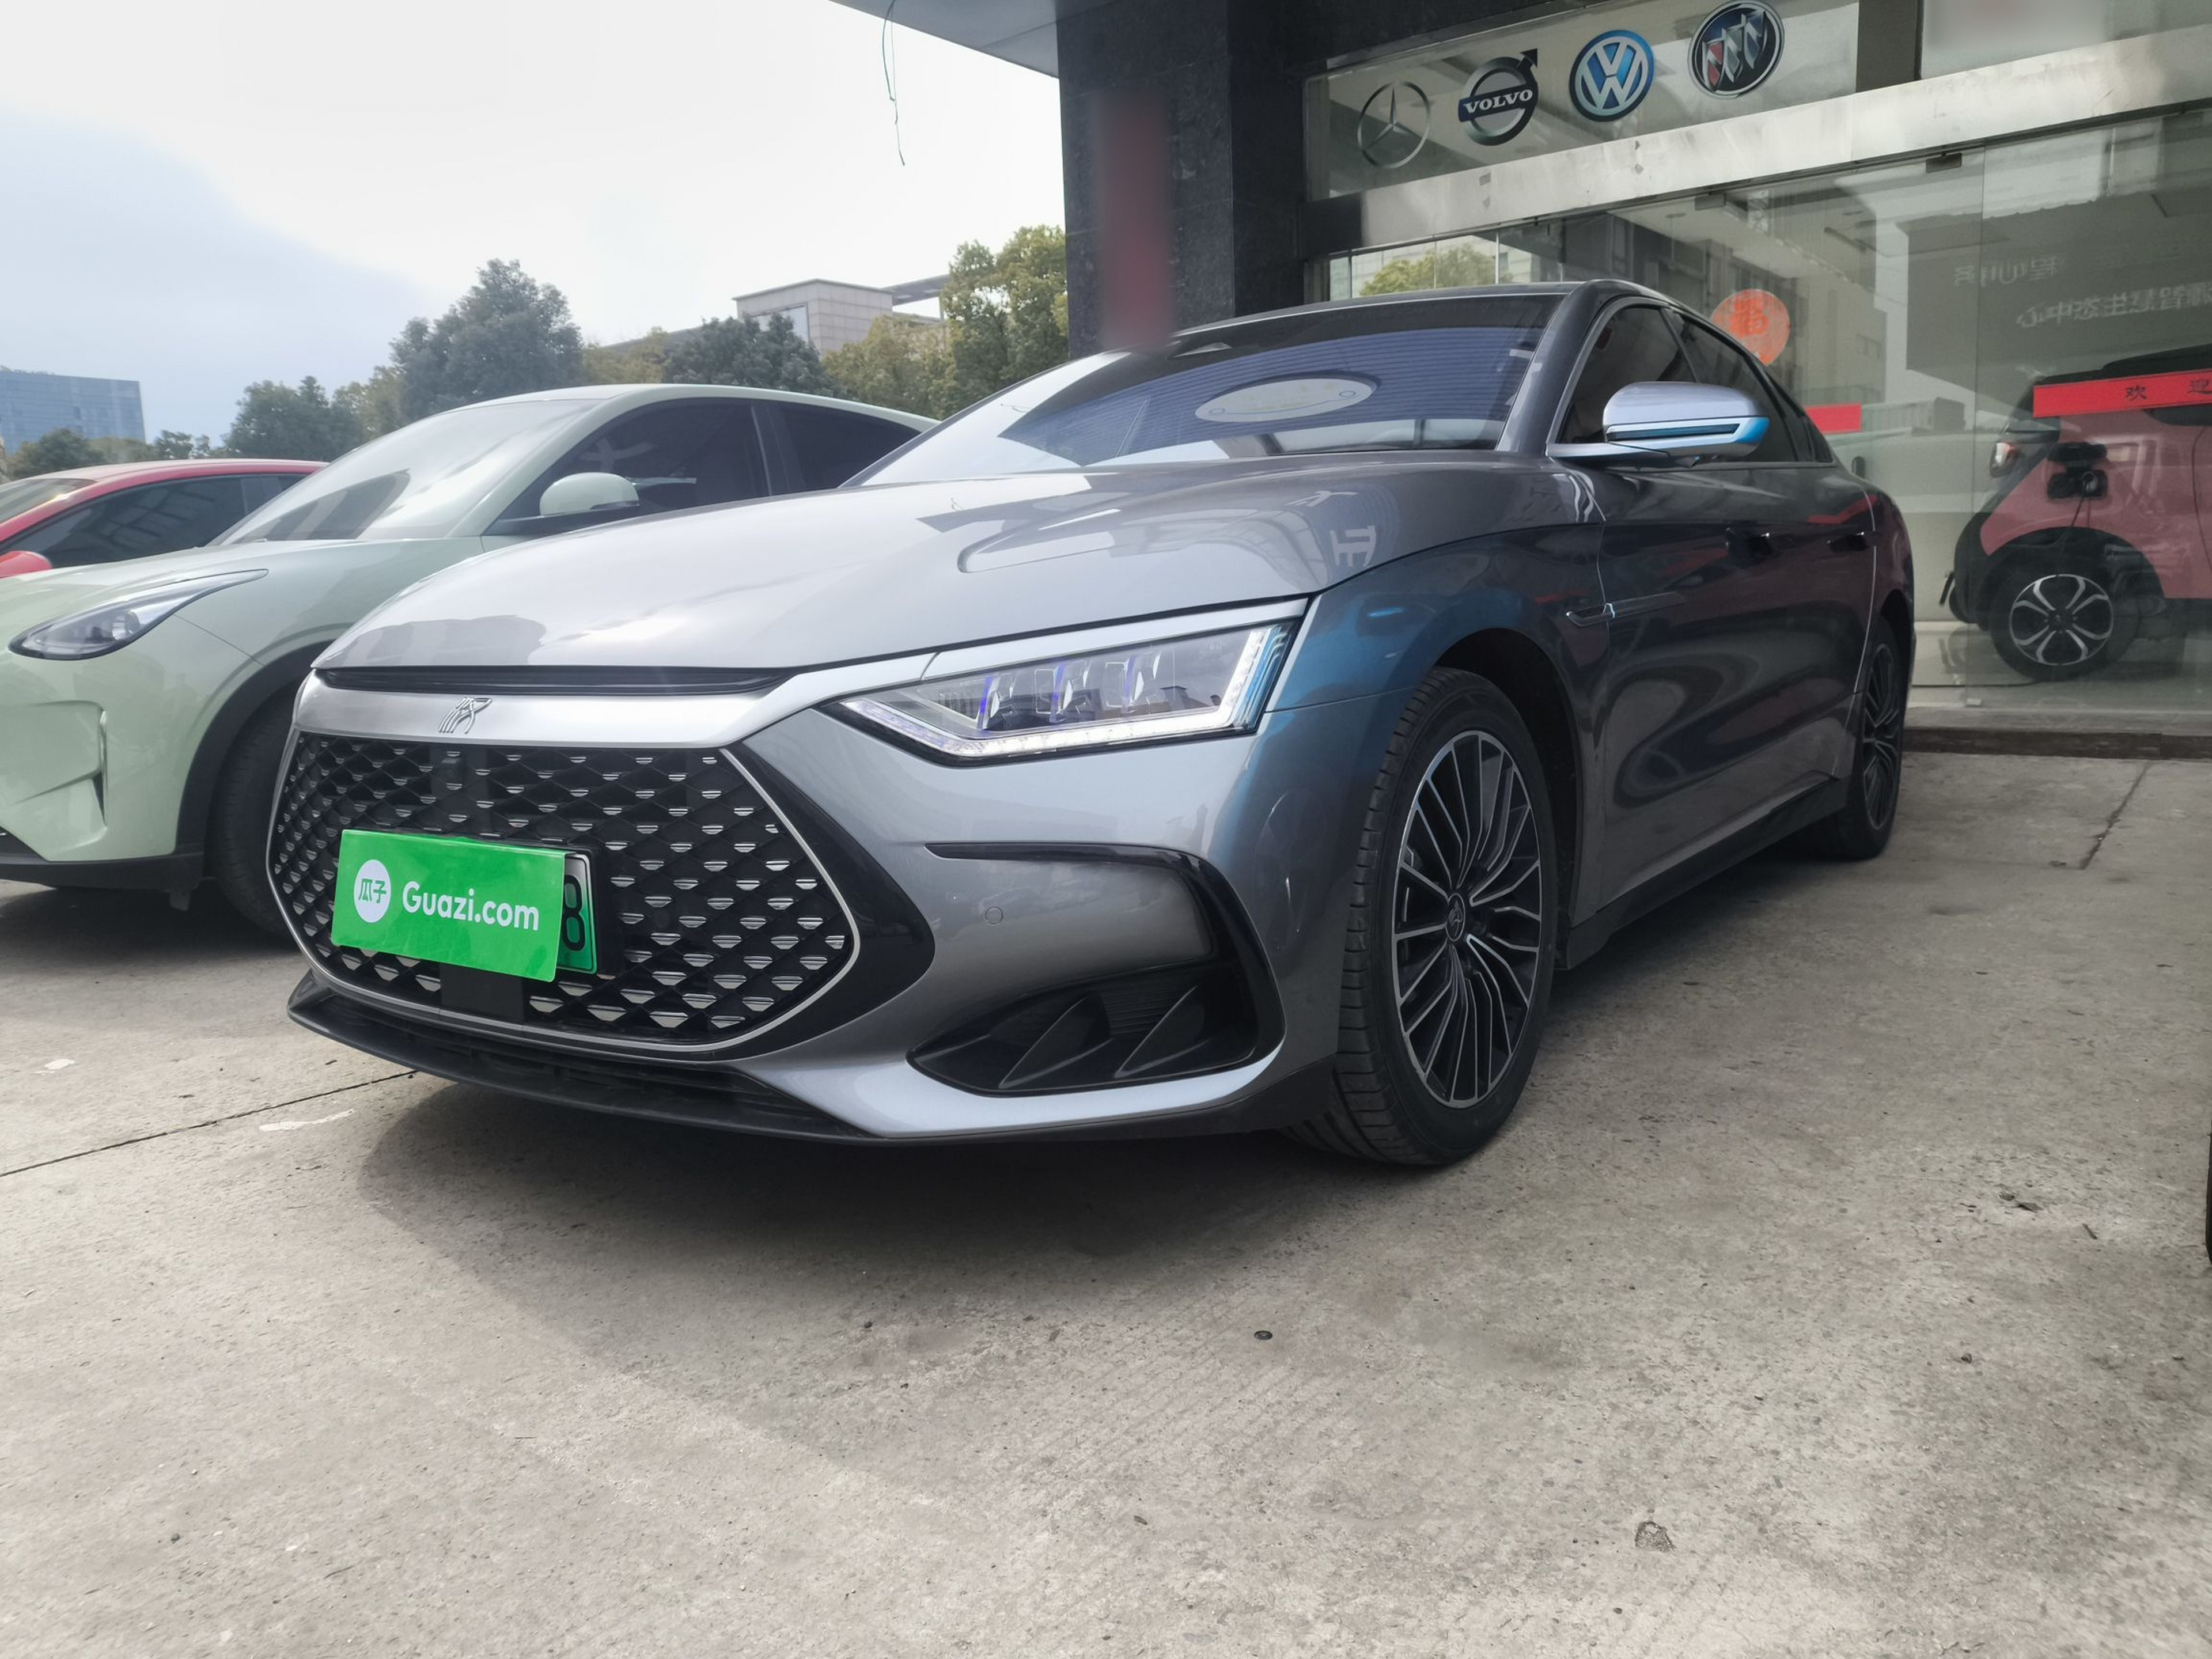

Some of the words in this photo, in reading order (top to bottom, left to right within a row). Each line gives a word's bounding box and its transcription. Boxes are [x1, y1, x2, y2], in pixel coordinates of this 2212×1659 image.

[1464, 89, 1532, 113] VOLVO
[359, 879, 387, 903] 瓜子
[403, 881, 539, 930] Guazi.com
[562, 875, 586, 951] 8
